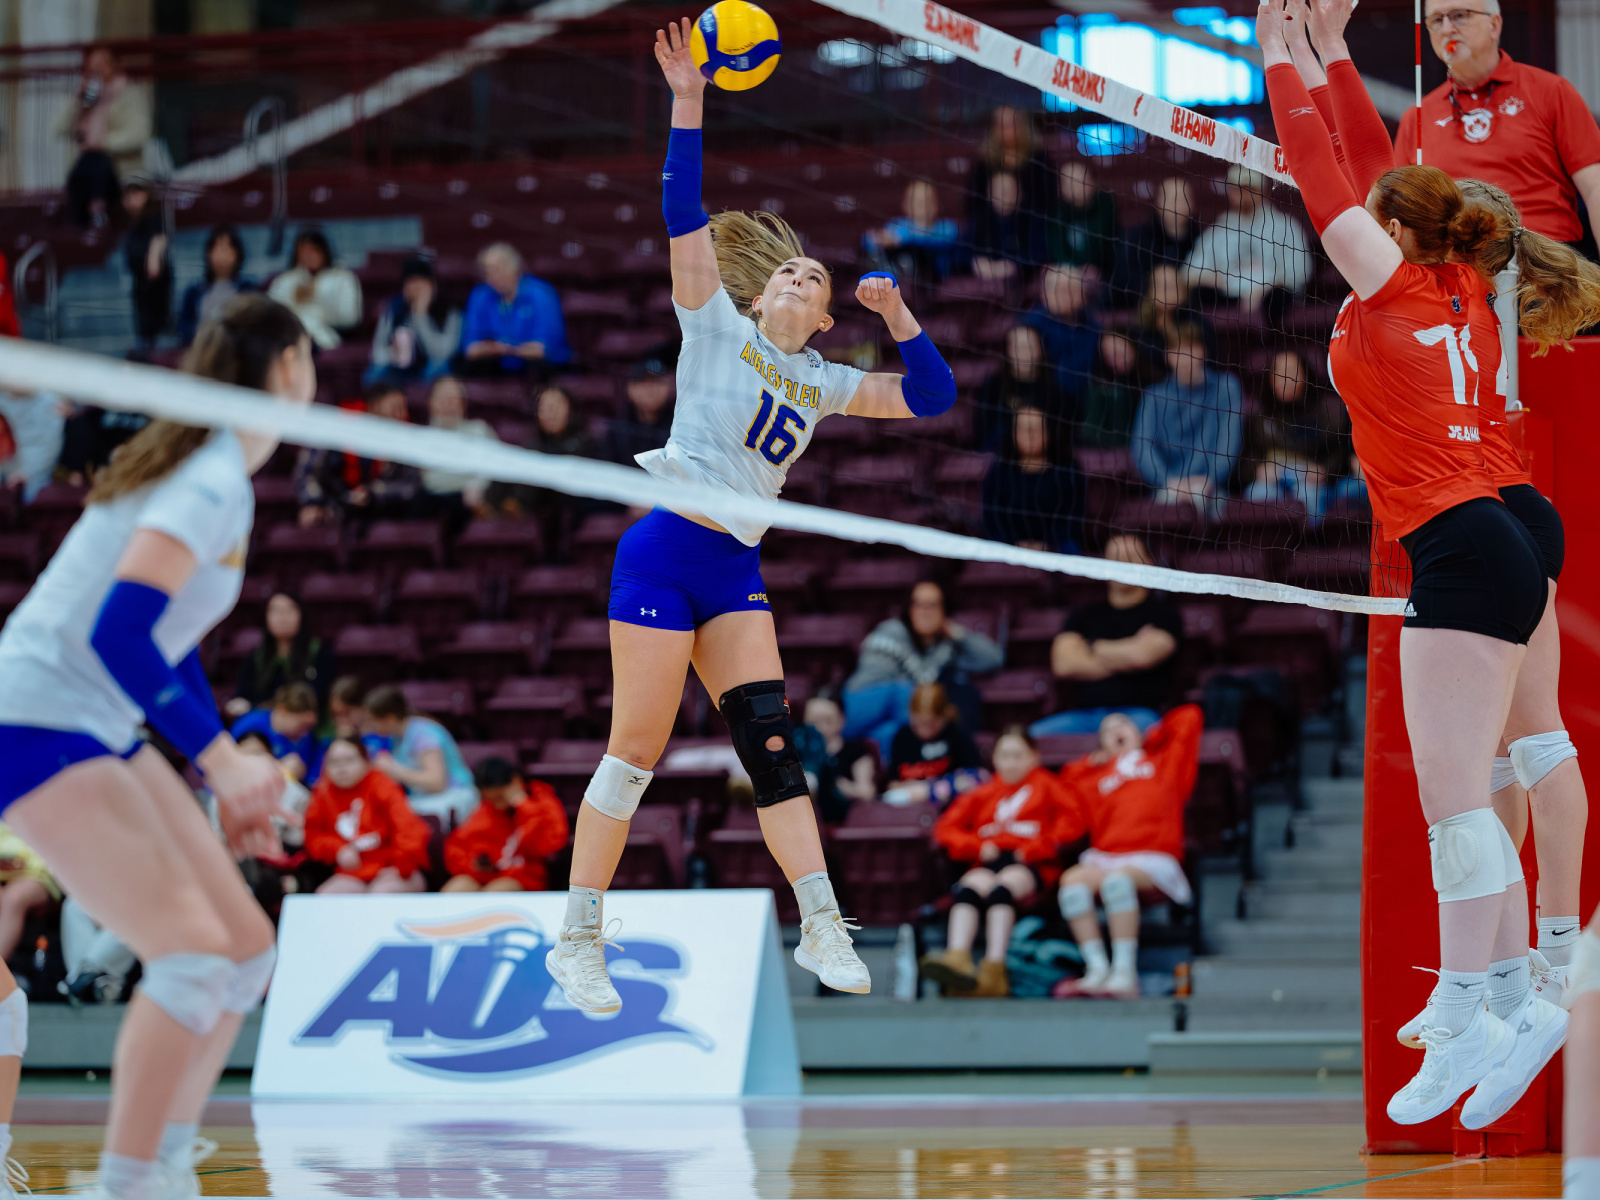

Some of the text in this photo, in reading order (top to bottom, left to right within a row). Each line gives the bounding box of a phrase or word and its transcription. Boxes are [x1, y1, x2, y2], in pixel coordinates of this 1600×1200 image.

[740, 341, 821, 410] AIGLES BLEU
[744, 386, 807, 467] 16
[291, 925, 716, 1079] AUS
